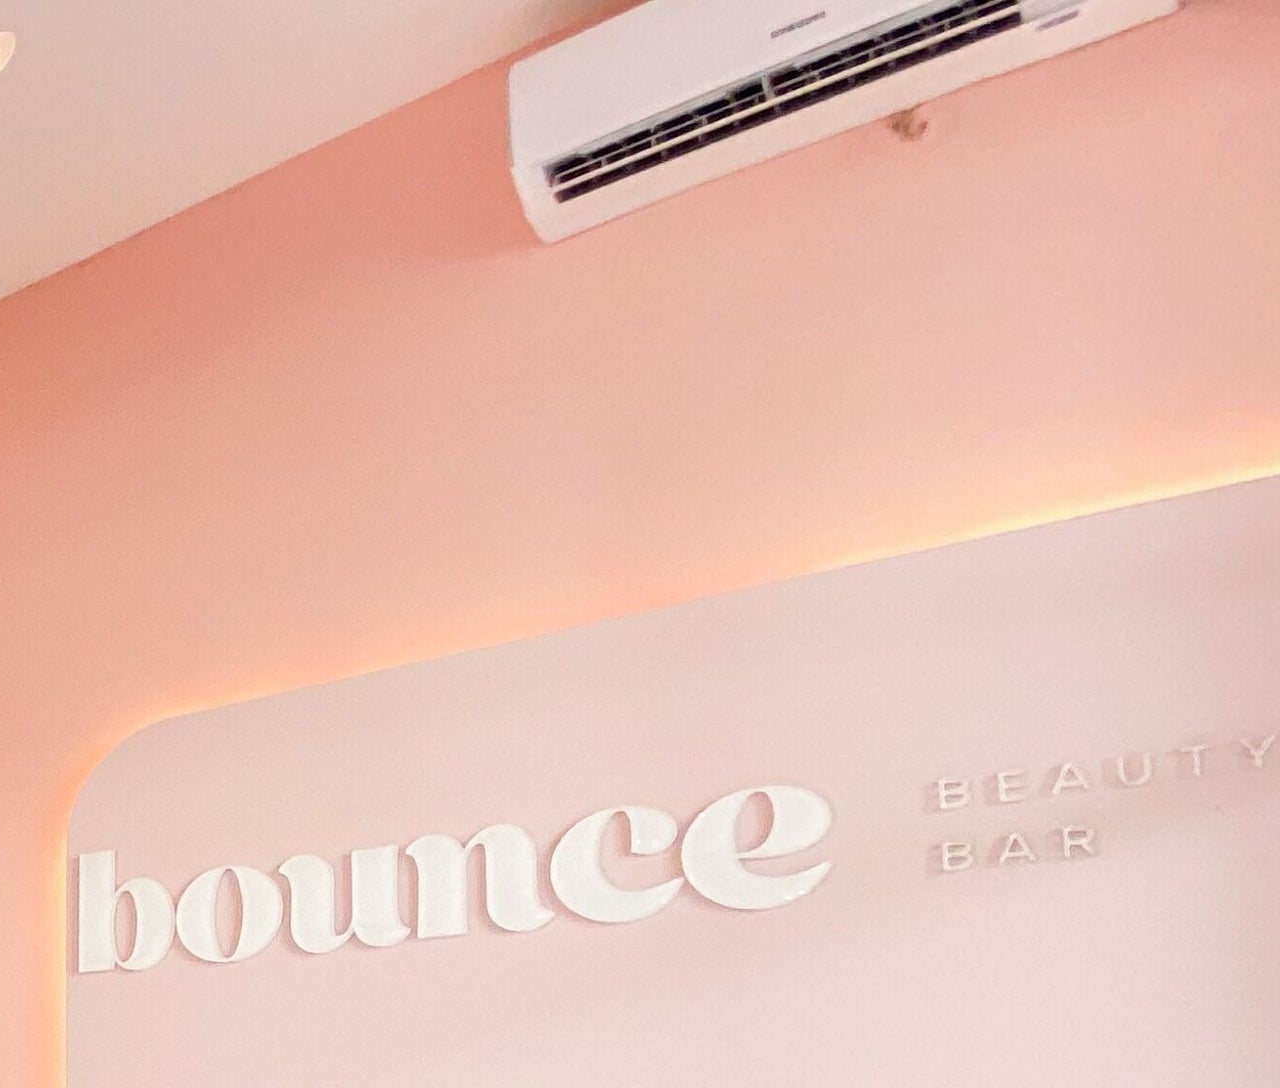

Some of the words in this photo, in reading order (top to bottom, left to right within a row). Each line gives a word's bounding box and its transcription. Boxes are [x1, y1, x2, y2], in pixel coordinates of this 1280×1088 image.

[937, 734, 1277, 810] BEAUTY
[77, 784, 833, 974] bounce
[941, 824, 1096, 872] BAR
